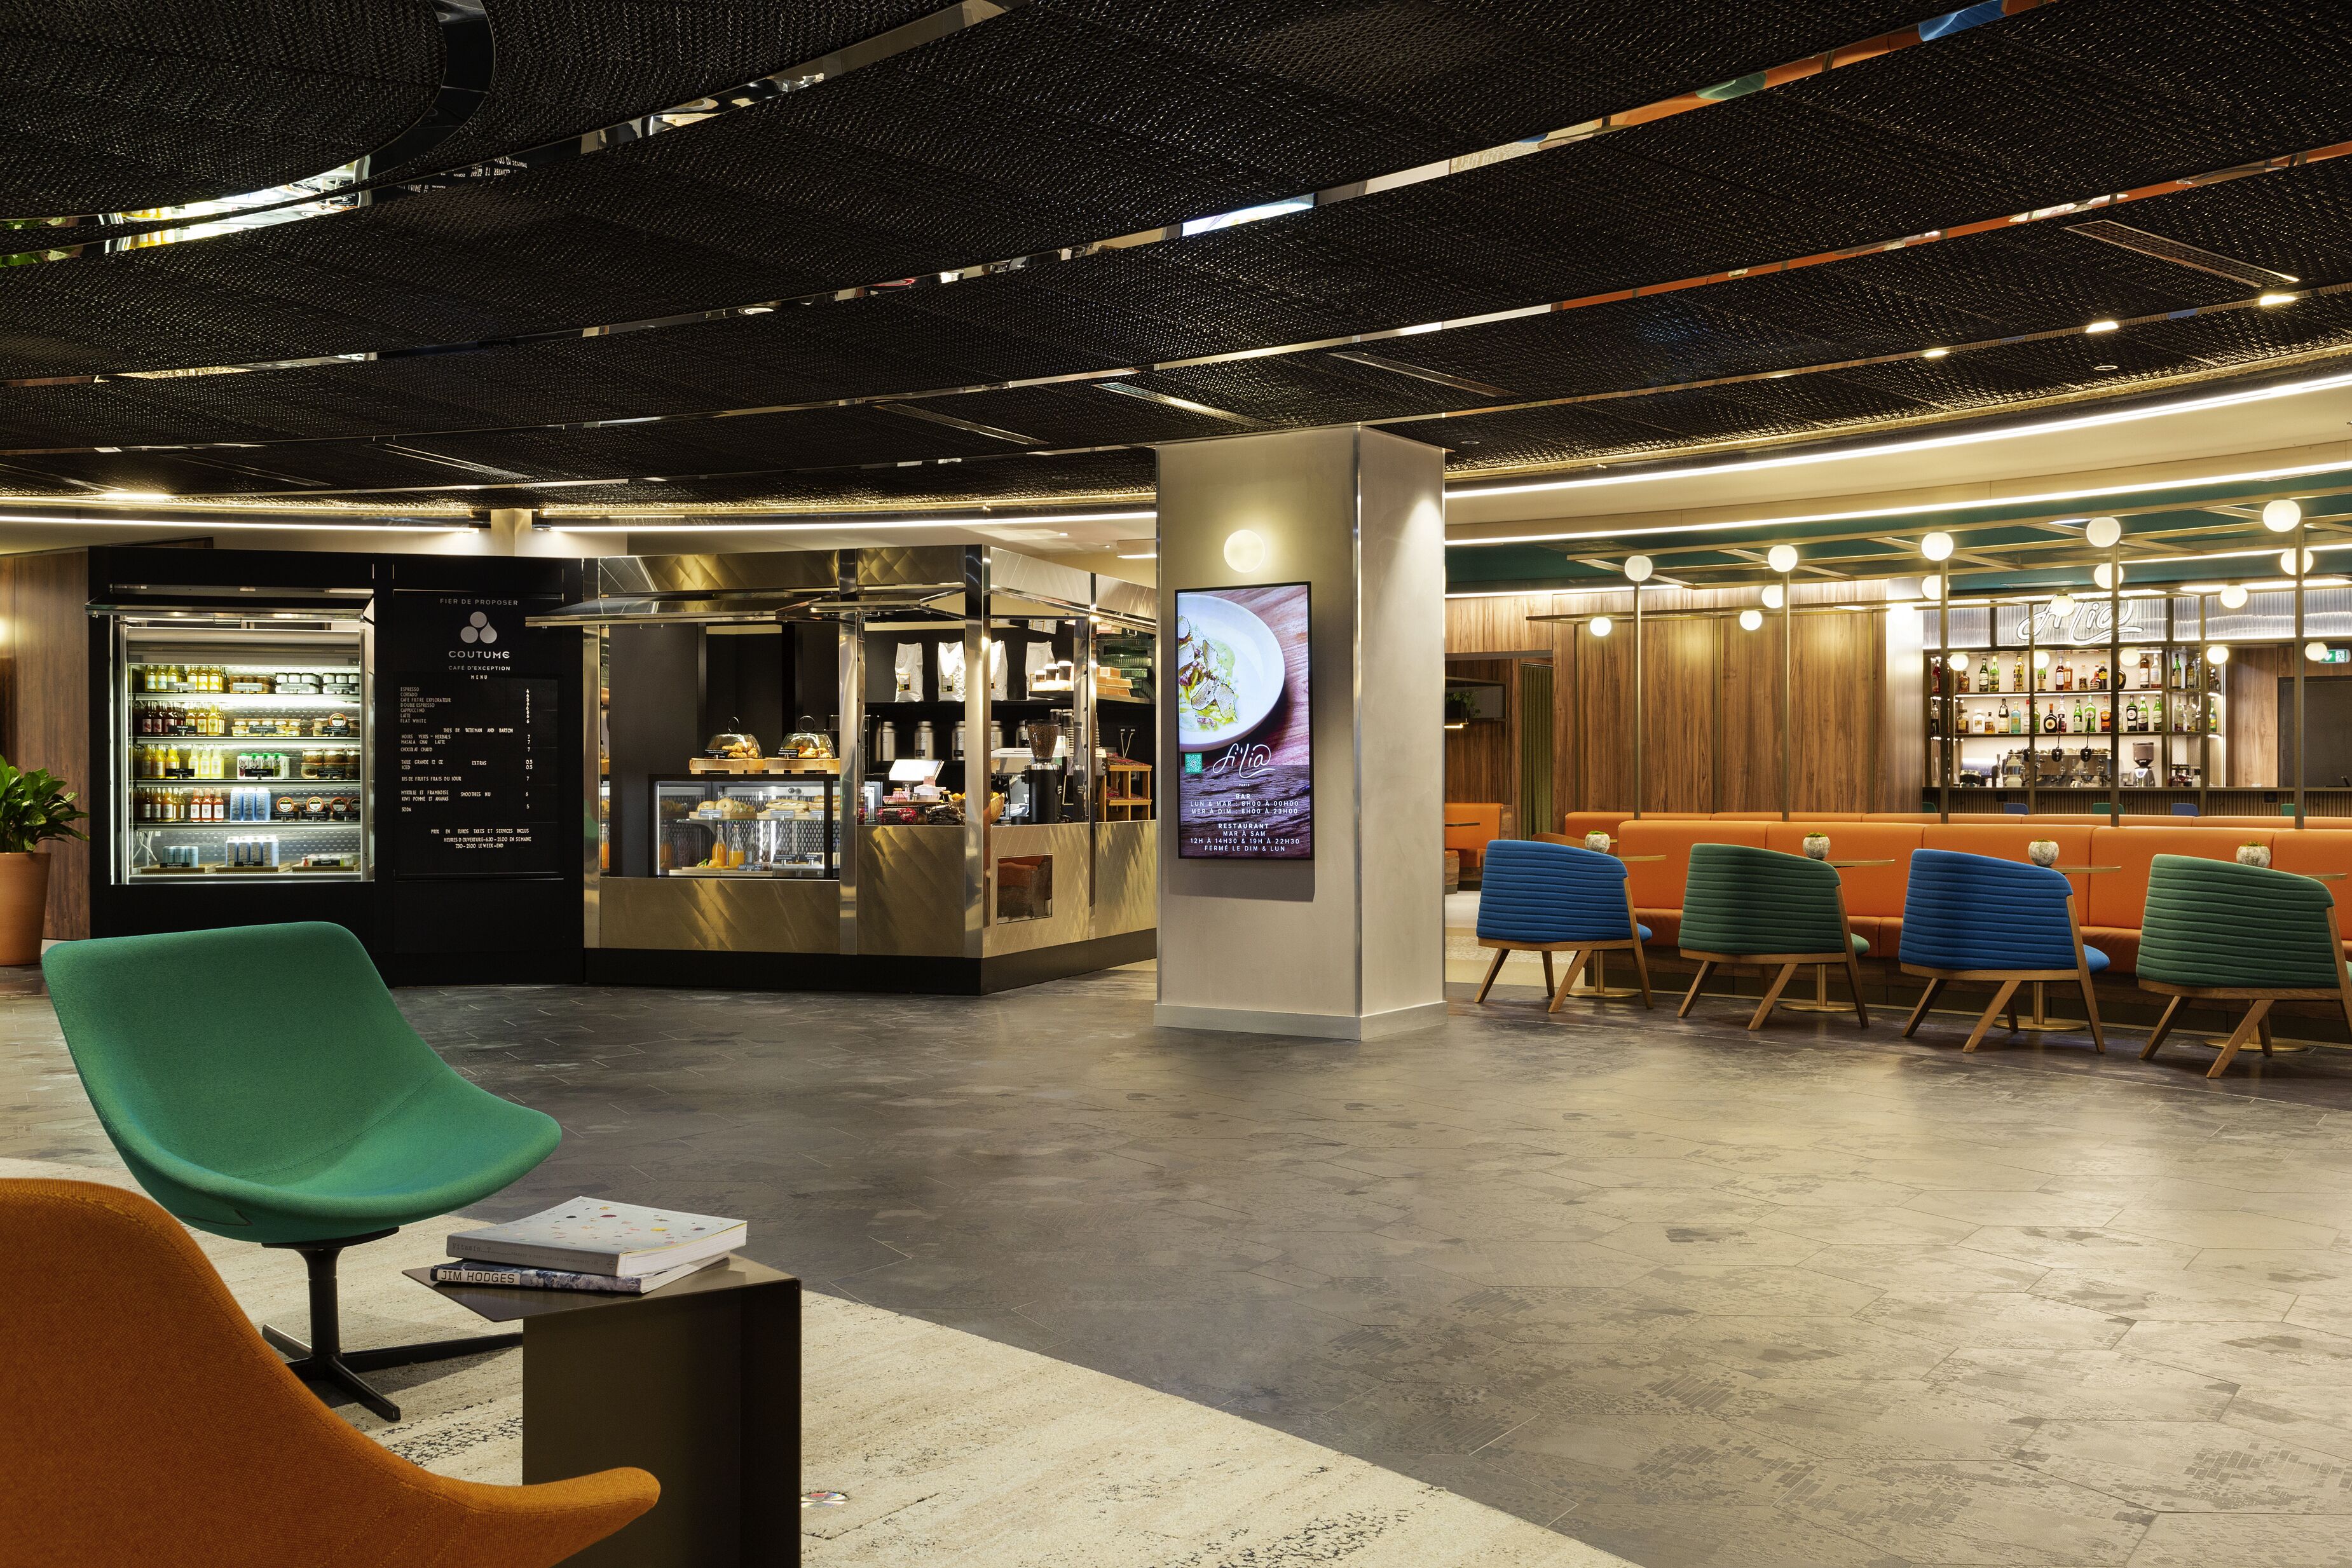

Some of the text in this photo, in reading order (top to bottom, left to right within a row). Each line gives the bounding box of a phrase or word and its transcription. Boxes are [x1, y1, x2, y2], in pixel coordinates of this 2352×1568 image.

[453, 1243, 481, 1252] Vitamin
[441, 1271, 515, 1283] JIM HODGES
